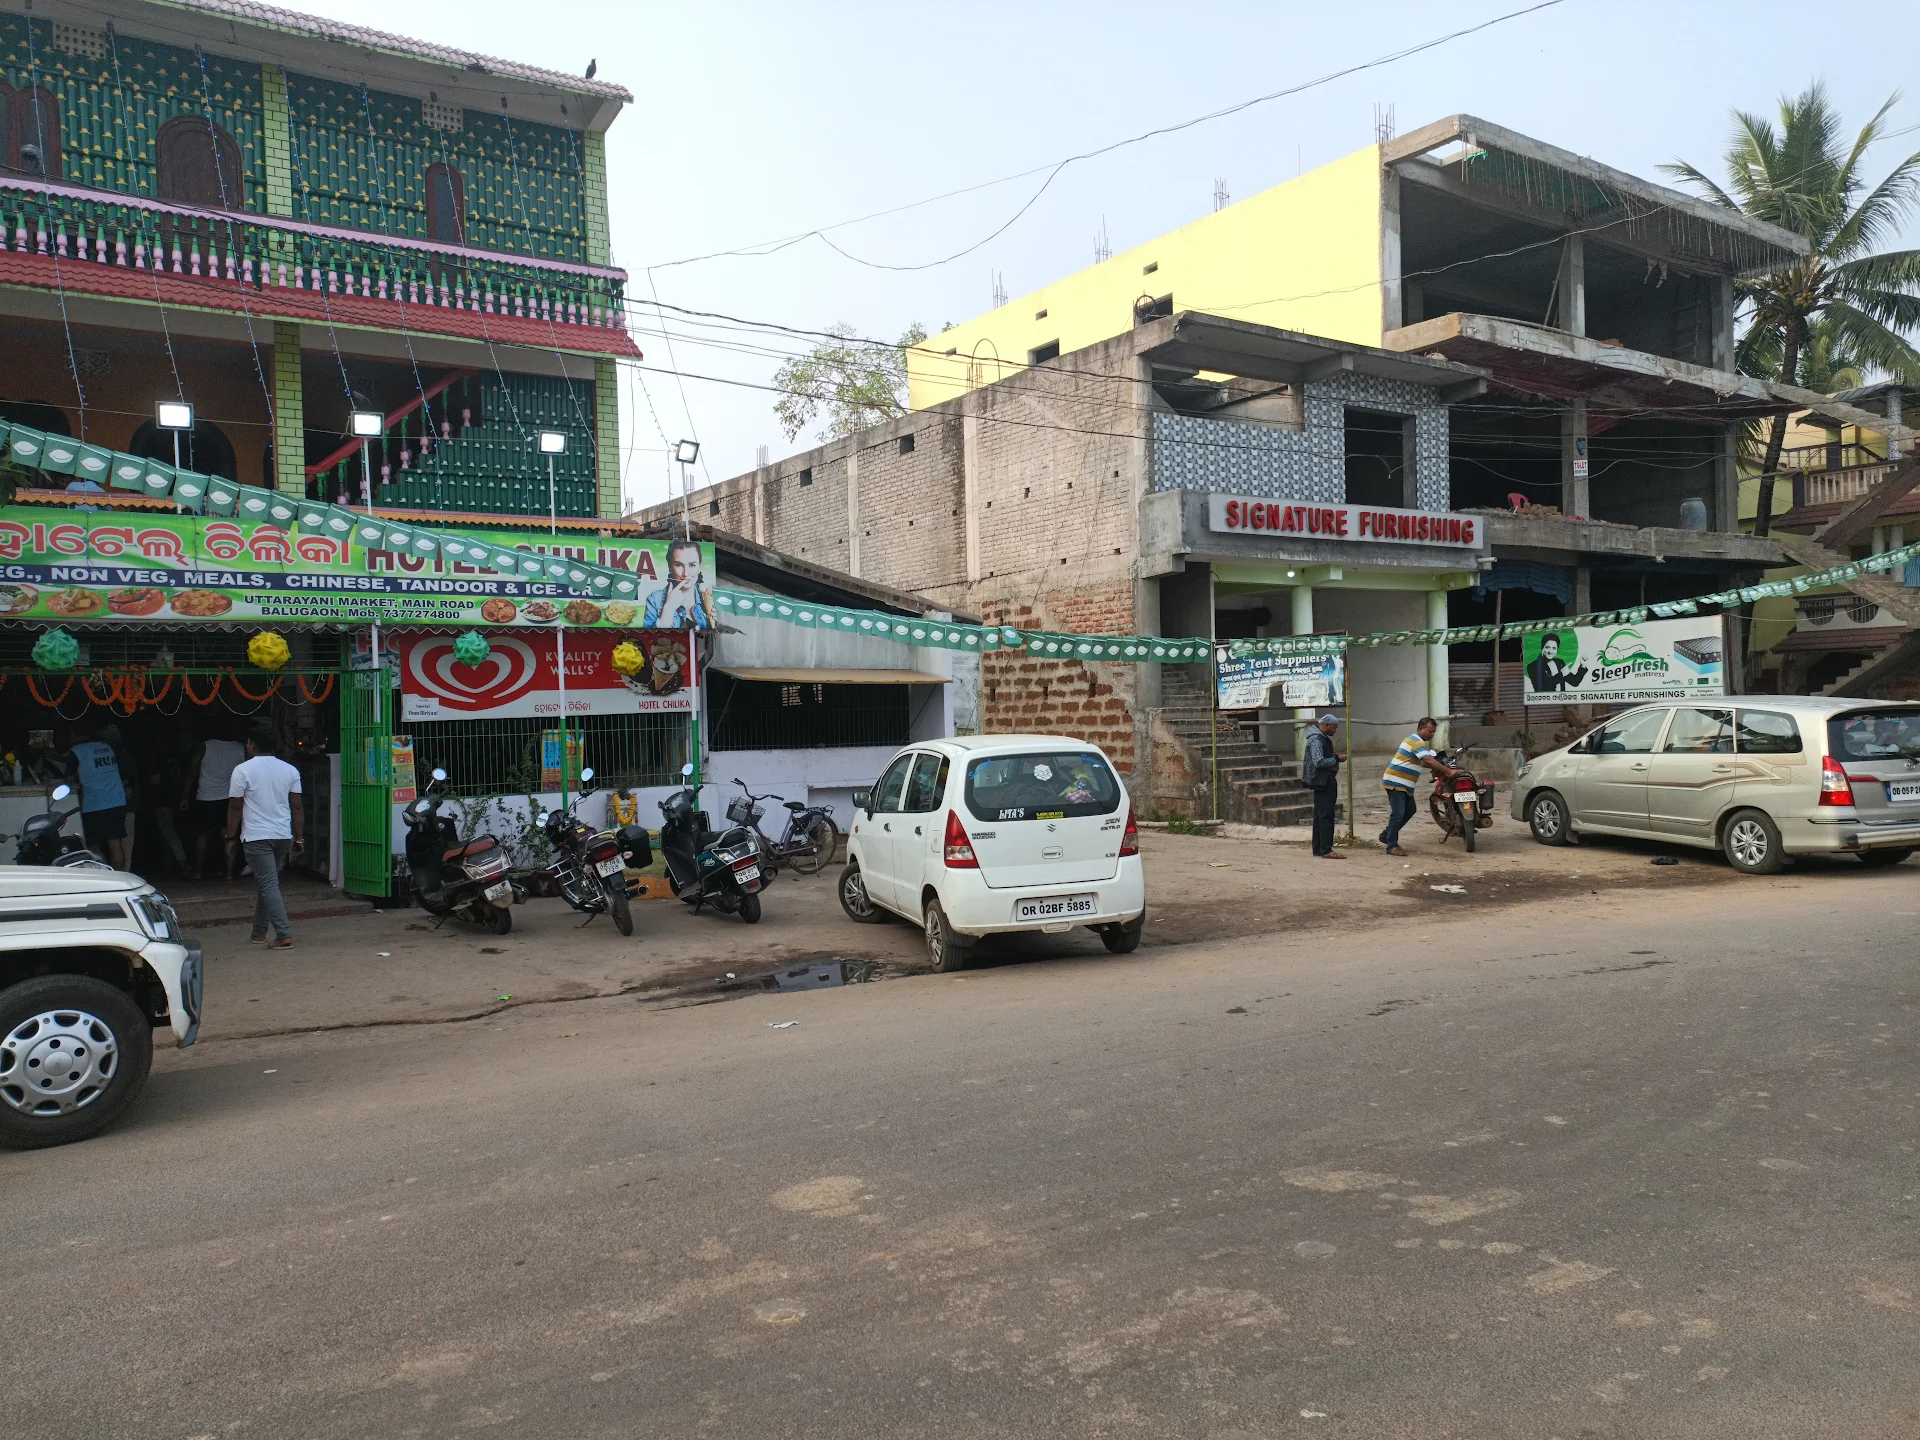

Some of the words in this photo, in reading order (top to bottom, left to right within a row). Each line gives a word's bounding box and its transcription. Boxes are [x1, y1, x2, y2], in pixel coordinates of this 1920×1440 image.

[1225, 499, 1348, 535] SIGNATURE
[1360, 511, 1474, 543] FURNISHING
[0, 565, 42, 582] G.,
[51, 567, 108, 582] NON
[116, 569, 176, 586] VEG,
[184, 571, 271, 589] MEALS,
[286, 574, 391, 592] CHINESE,
[397, 579, 498, 594] TANDOOR
[504, 582, 519, 594] &
[244, 595, 334, 606] UTTARAYANI
[338, 597, 398, 609] MARKET,
[402, 599, 436, 608] MAIN
[440, 600, 475, 609] ROAD
[261, 606, 344, 618] BALUGAON,
[348, 608, 379, 618] Mob.
[383, 609, 460, 619] 7377274800
[1219, 663, 1246, 674] Shree
[1249, 657, 1273, 669] Tent
[1580, 692, 1626, 701] SIGNATURE
[1627, 690, 1686, 699] FURNISHINGS
[638, 700, 662, 710] HOTEL
[663, 699, 691, 710] CHILIKA
[1022, 905, 1036, 916] OR
[1039, 903, 1063, 914] 02BF
[1067, 900, 1091, 912] 5885
